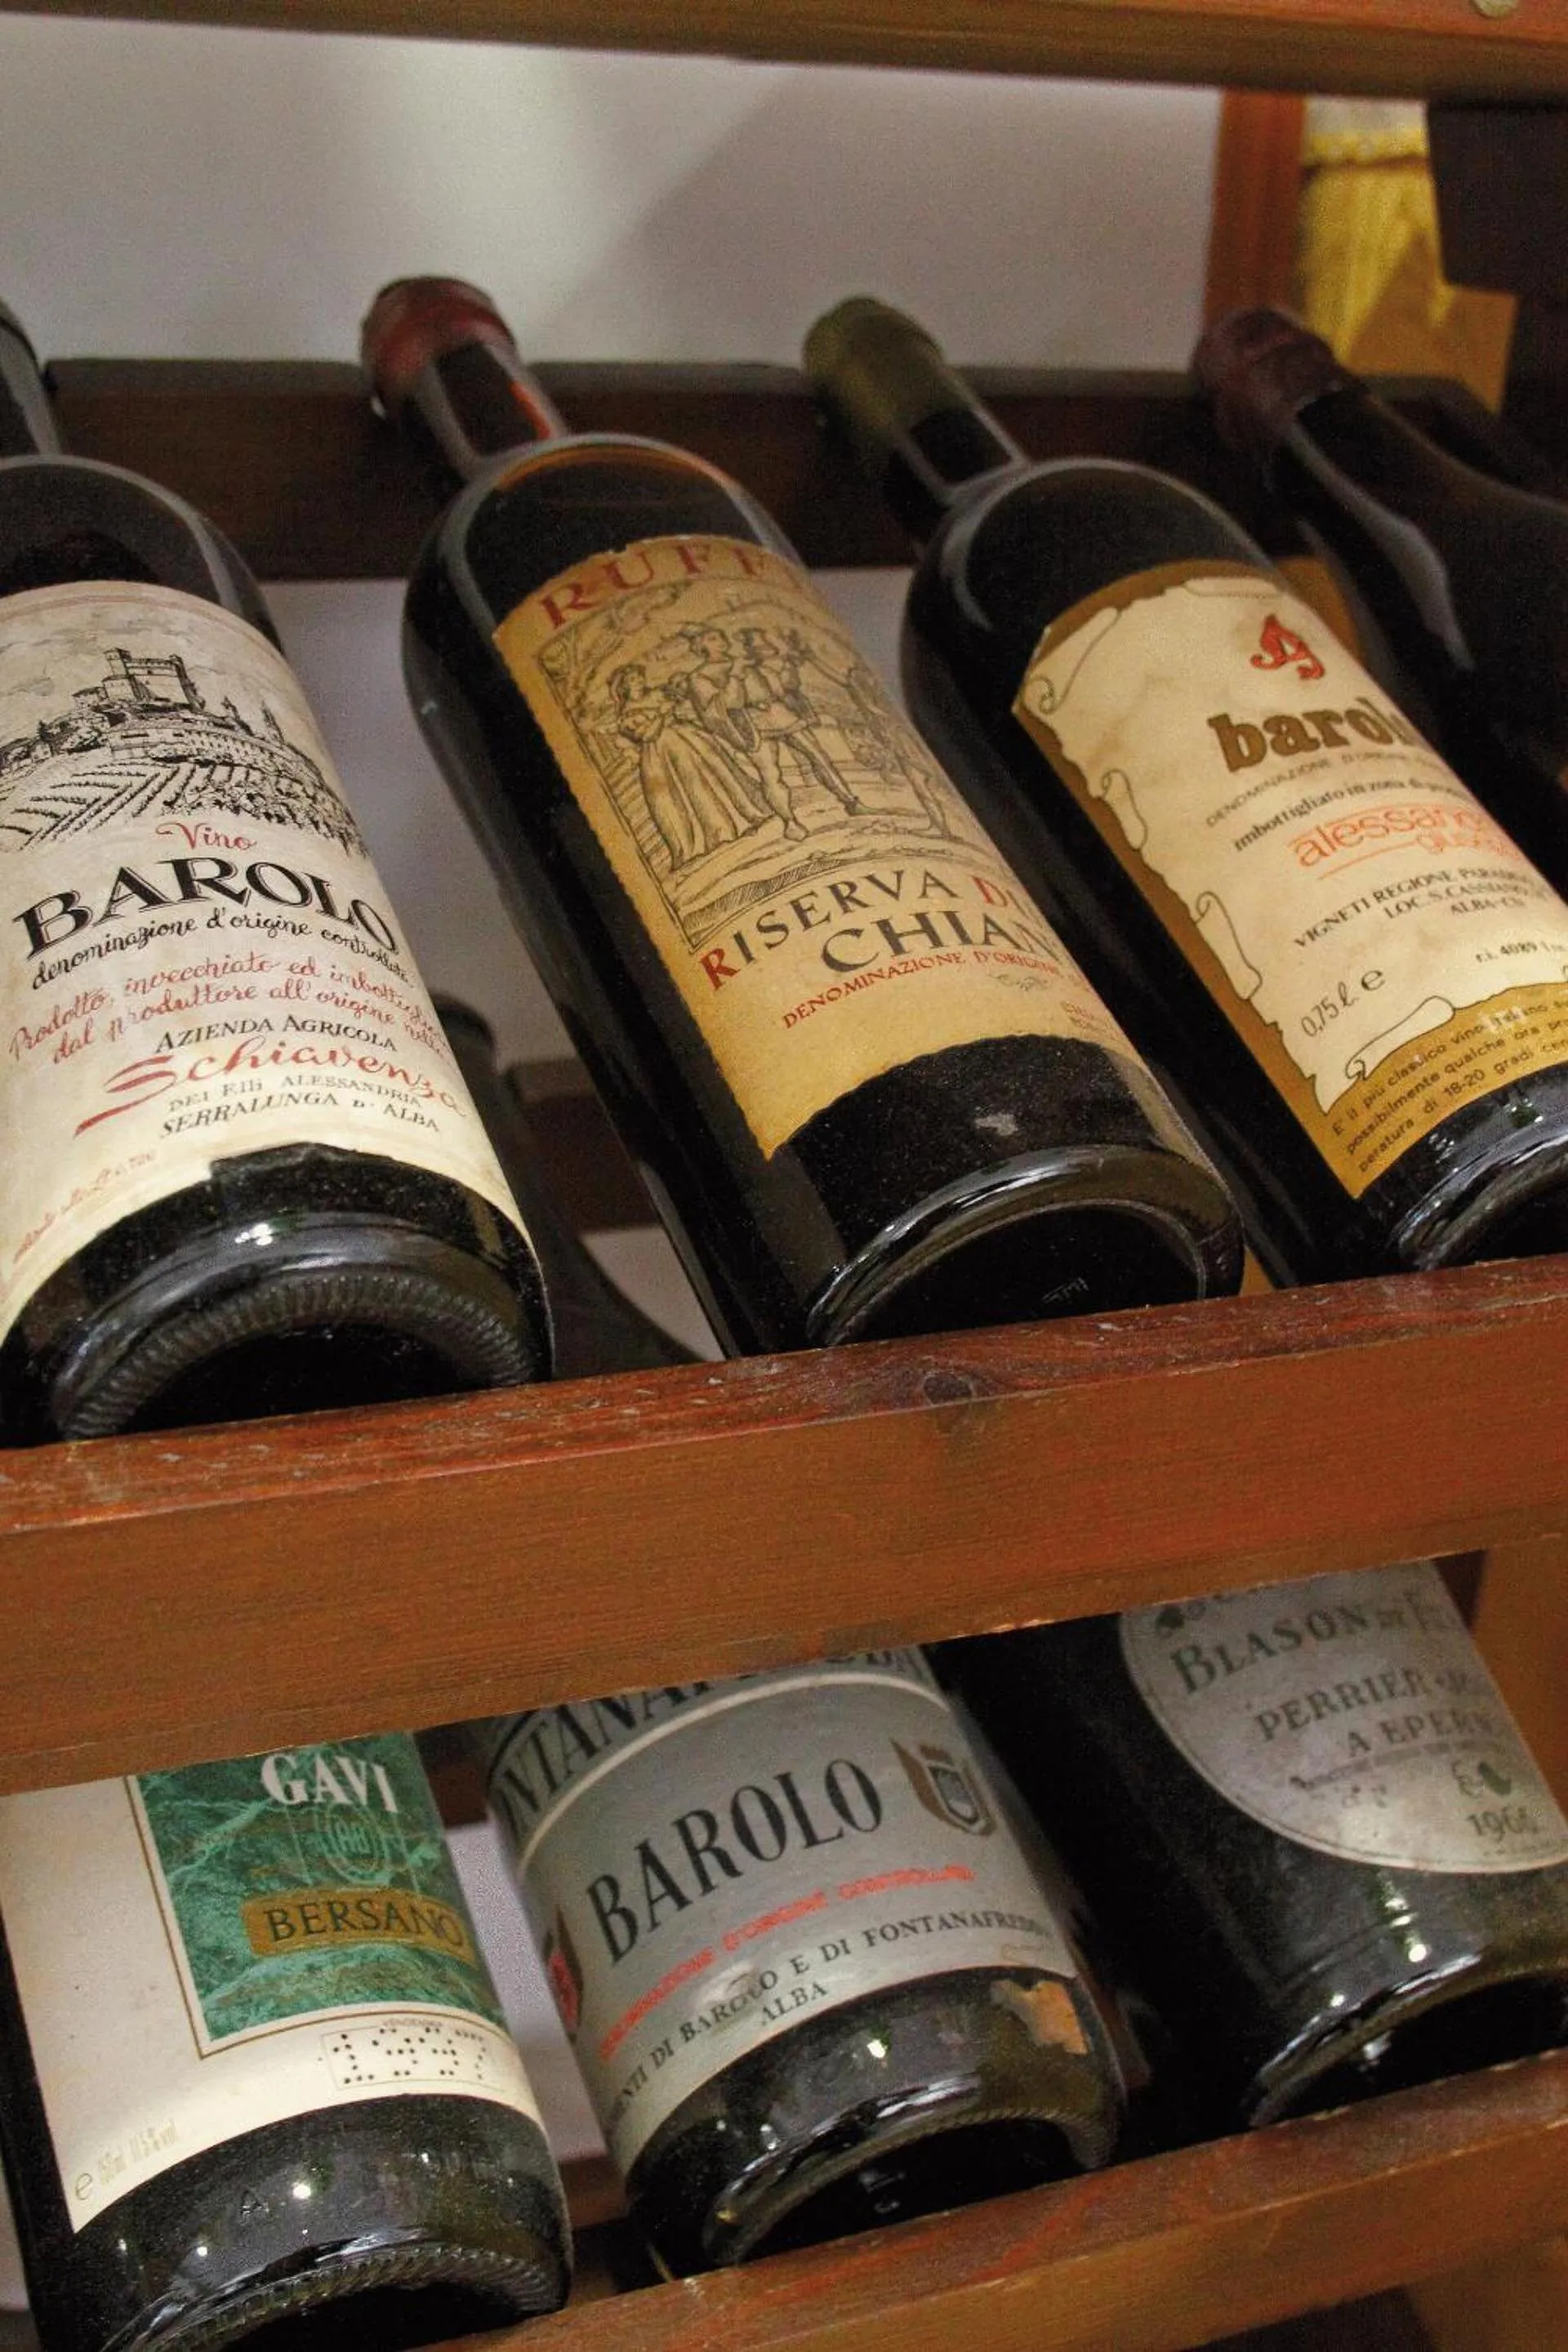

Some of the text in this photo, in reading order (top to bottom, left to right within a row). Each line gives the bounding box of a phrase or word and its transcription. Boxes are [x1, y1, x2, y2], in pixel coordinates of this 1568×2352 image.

[155, 822, 258, 852] Vino
[12, 856, 399, 961] BAROLO
[698, 870, 960, 991] RISERVA
[1294, 897, 1372, 948] VIGNETI
[1373, 870, 1457, 905] REGIONE
[32, 917, 198, 991] denominazione
[206, 906, 312, 938] d'origine
[124, 951, 281, 996] invecchiato
[289, 956, 319, 978] ed
[782, 951, 966, 1029] DENOMINAZIONE
[53, 1018, 94, 1064] dal
[315, 991, 395, 1026] origine
[155, 1018, 274, 1054] AZIENDA
[283, 1013, 398, 1053] AGRICOLA
[1444, 1036, 1506, 1075] qualche
[280, 1075, 423, 1108] ALESSANDRIA
[1423, 1098, 1439, 1115] di
[1443, 1068, 1486, 1098] 18-20
[1493, 1049, 1535, 1076] gradi
[158, 1092, 339, 1139] SERRALUNGA
[383, 1102, 440, 1134] ALBA
[1170, 1603, 1375, 1695] BLASON
[260, 1753, 399, 1814] GAVI
[586, 1758, 884, 1963] BAROLO
[263, 1899, 465, 1947] BERSANO
[649, 2038, 675, 2070] DI
[789, 1953, 811, 1976] E
[820, 1937, 852, 1962] DI
[760, 1981, 828, 2027] ALBA
